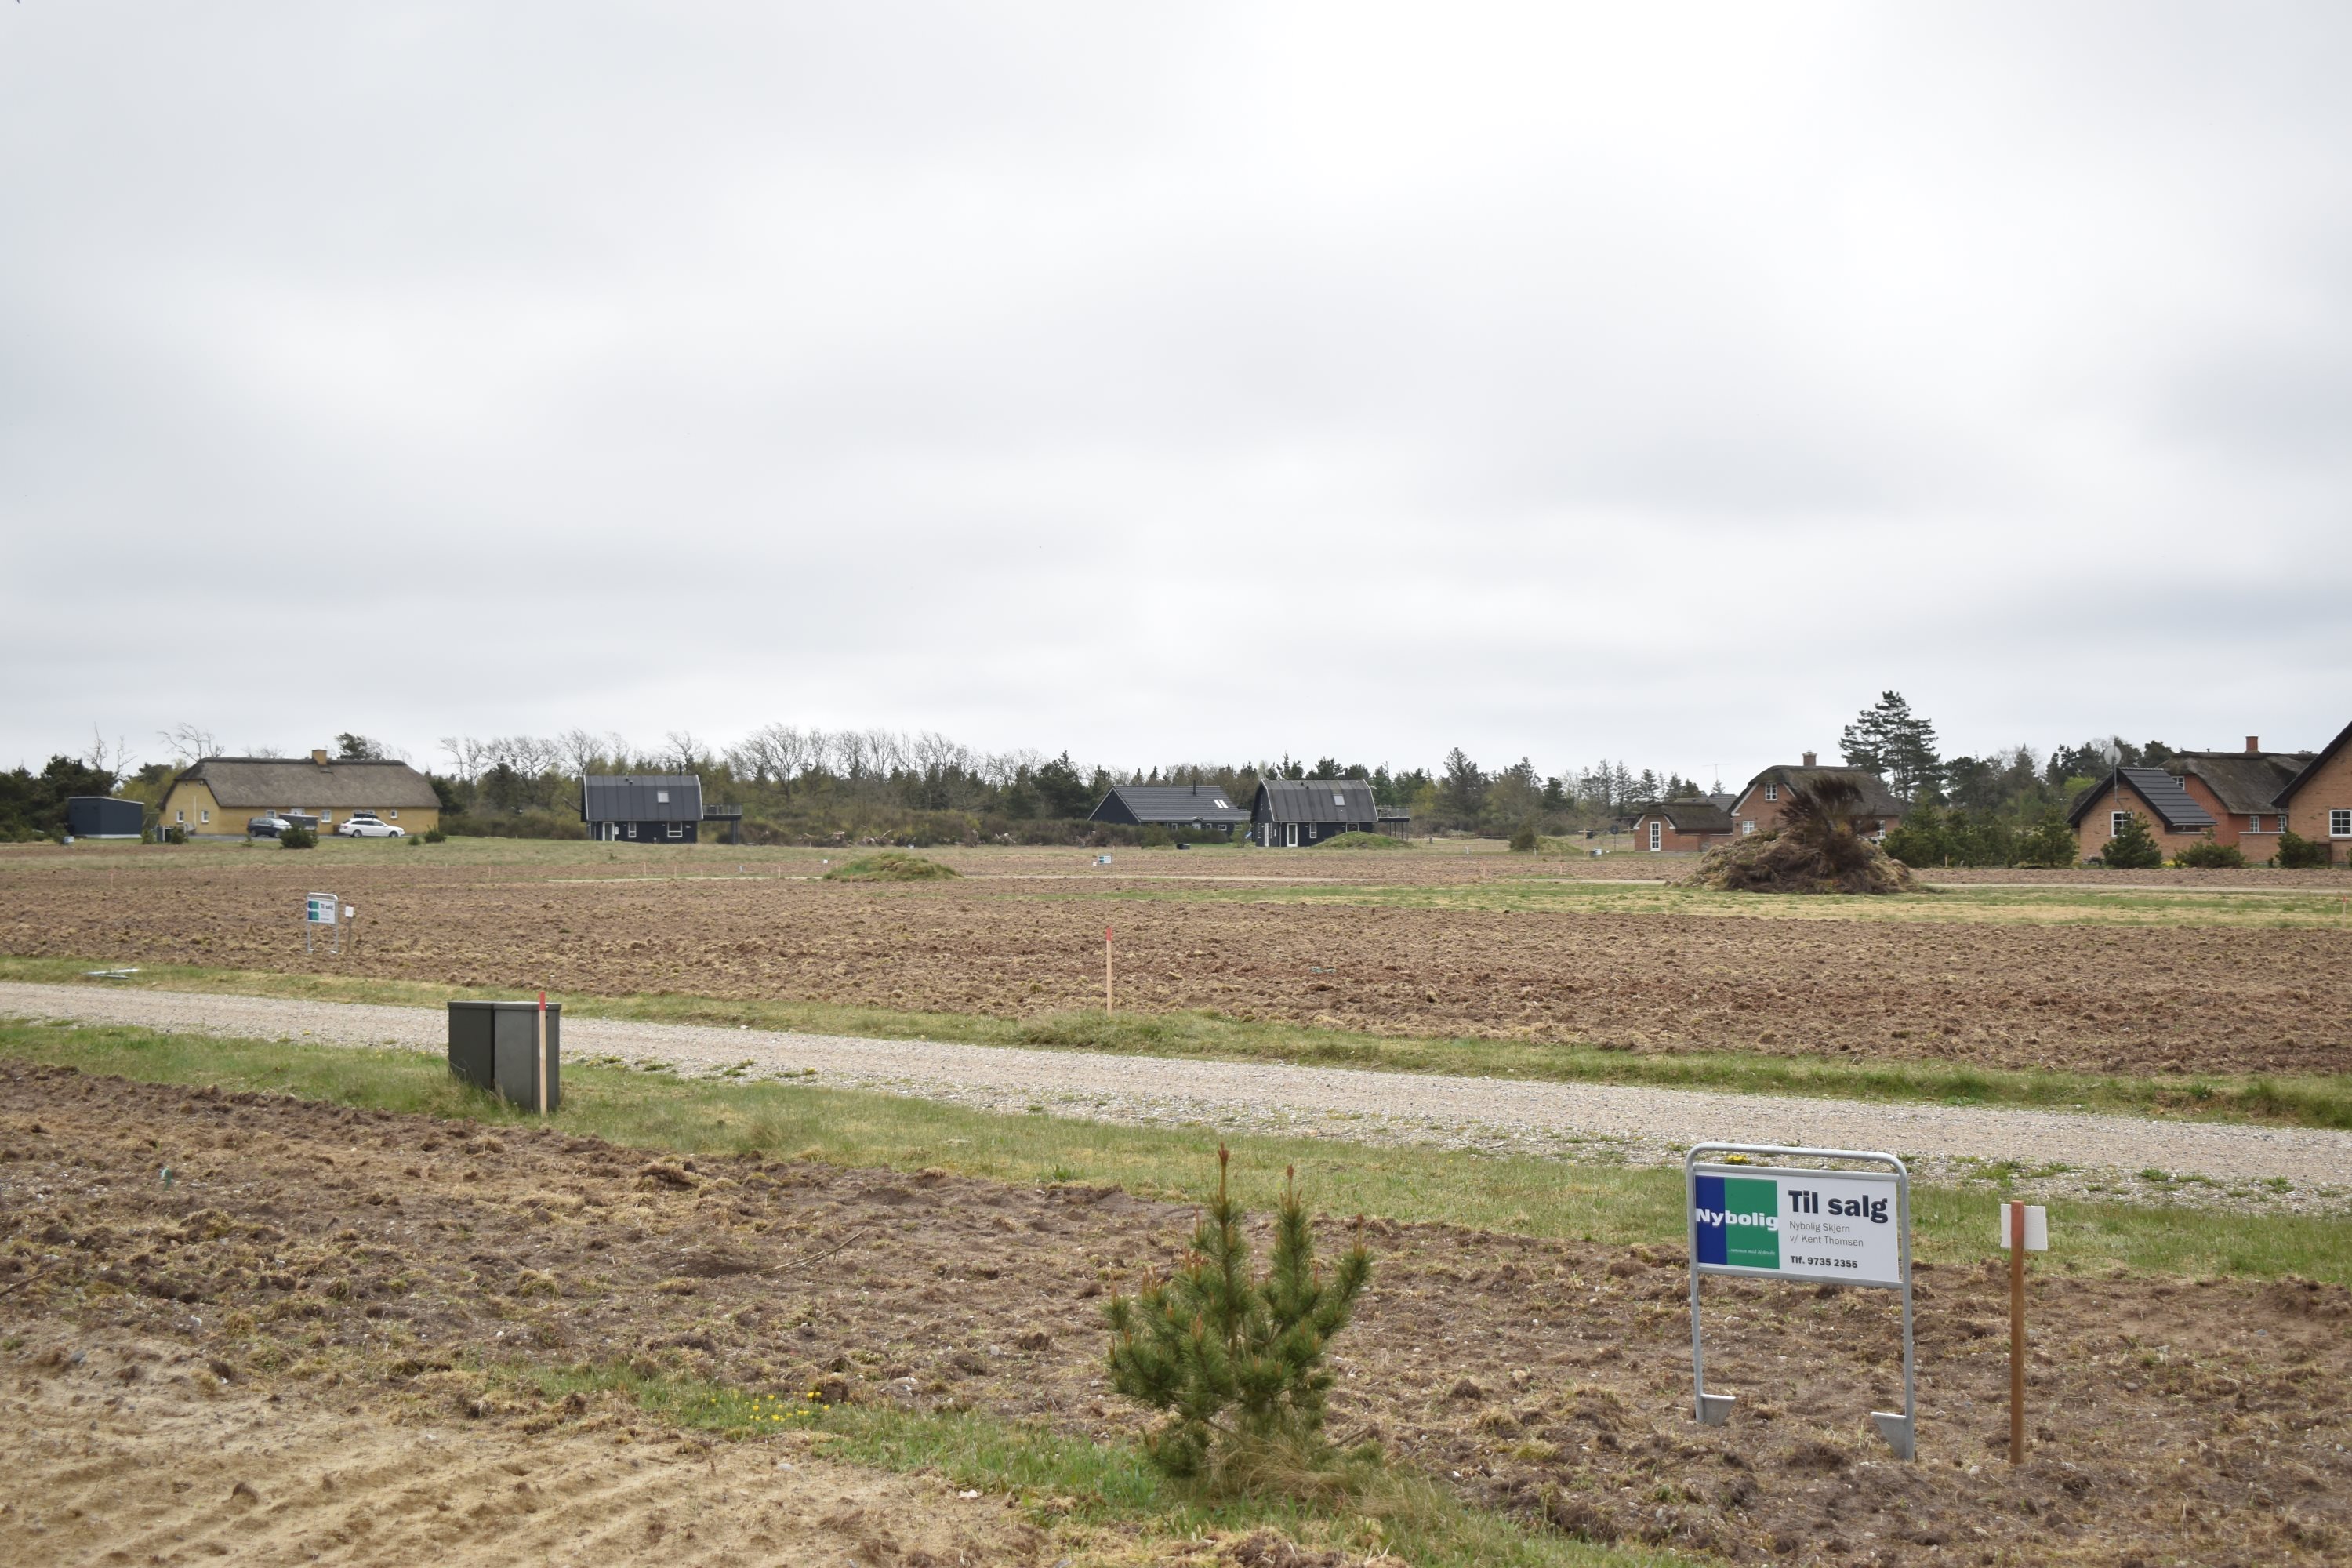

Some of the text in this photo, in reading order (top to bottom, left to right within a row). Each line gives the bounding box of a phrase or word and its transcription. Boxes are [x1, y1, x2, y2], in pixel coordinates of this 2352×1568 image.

[1788, 1189, 1889, 1224] Til salg
[1695, 1208, 1778, 1231] Nybolig
[1789, 1221, 1850, 1233] Nybolig Skjern
[1789, 1235, 1864, 1247] v/ Kent Thomsen
[1790, 1255, 1858, 1268] Tlf. 9735 2355
